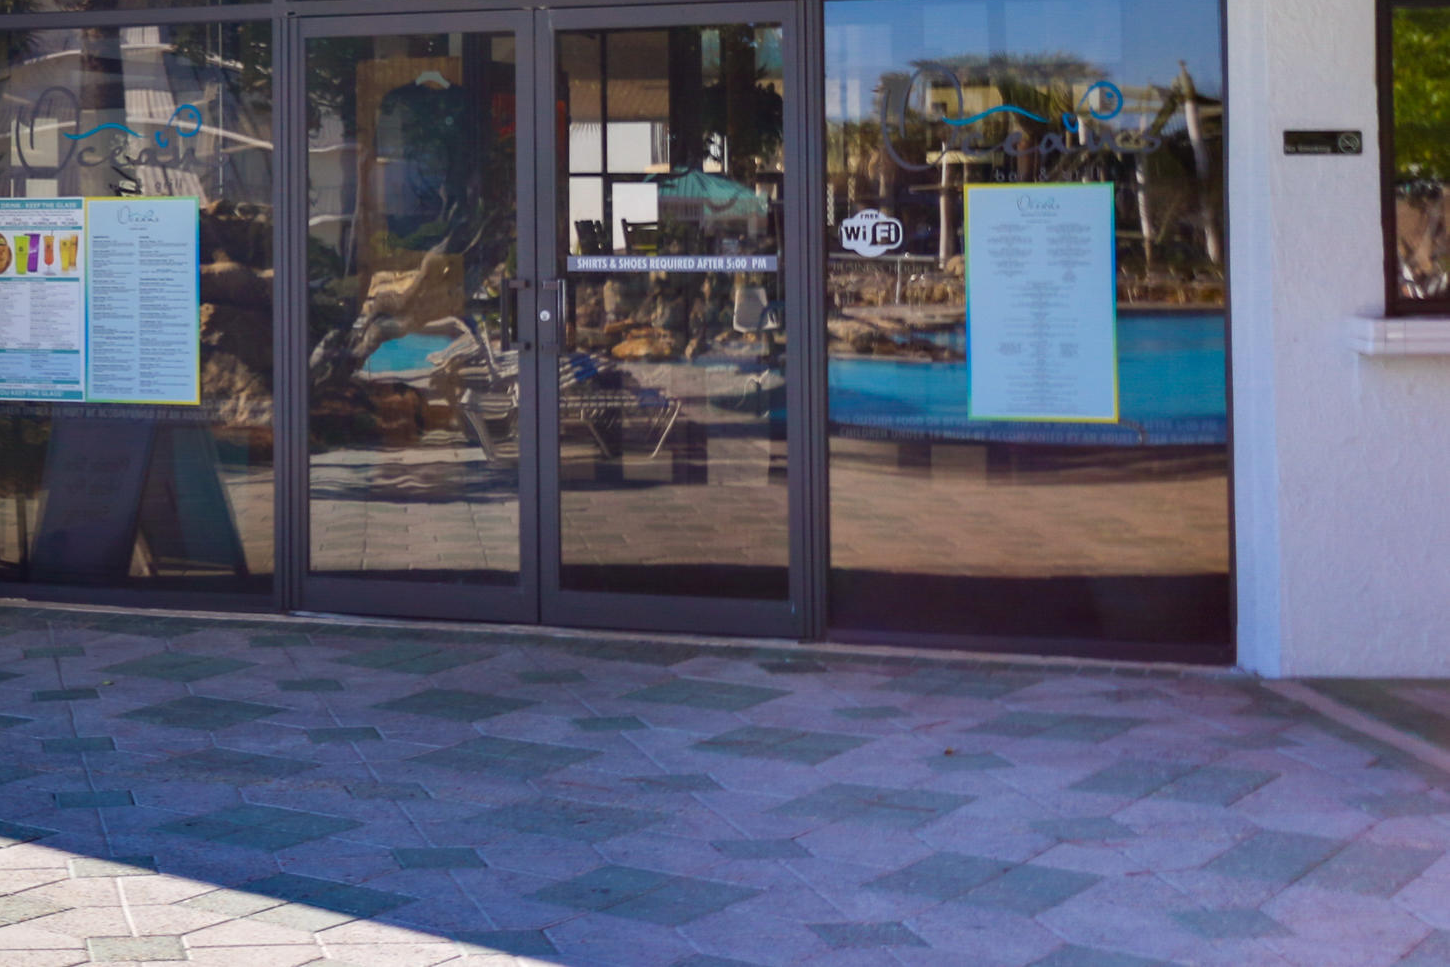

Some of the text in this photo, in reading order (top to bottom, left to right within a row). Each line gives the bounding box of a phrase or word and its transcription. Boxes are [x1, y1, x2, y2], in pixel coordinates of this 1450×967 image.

[576, 257, 767, 270] SHIRTS & SHOES REQUIRED AFTER 5:00 PM
